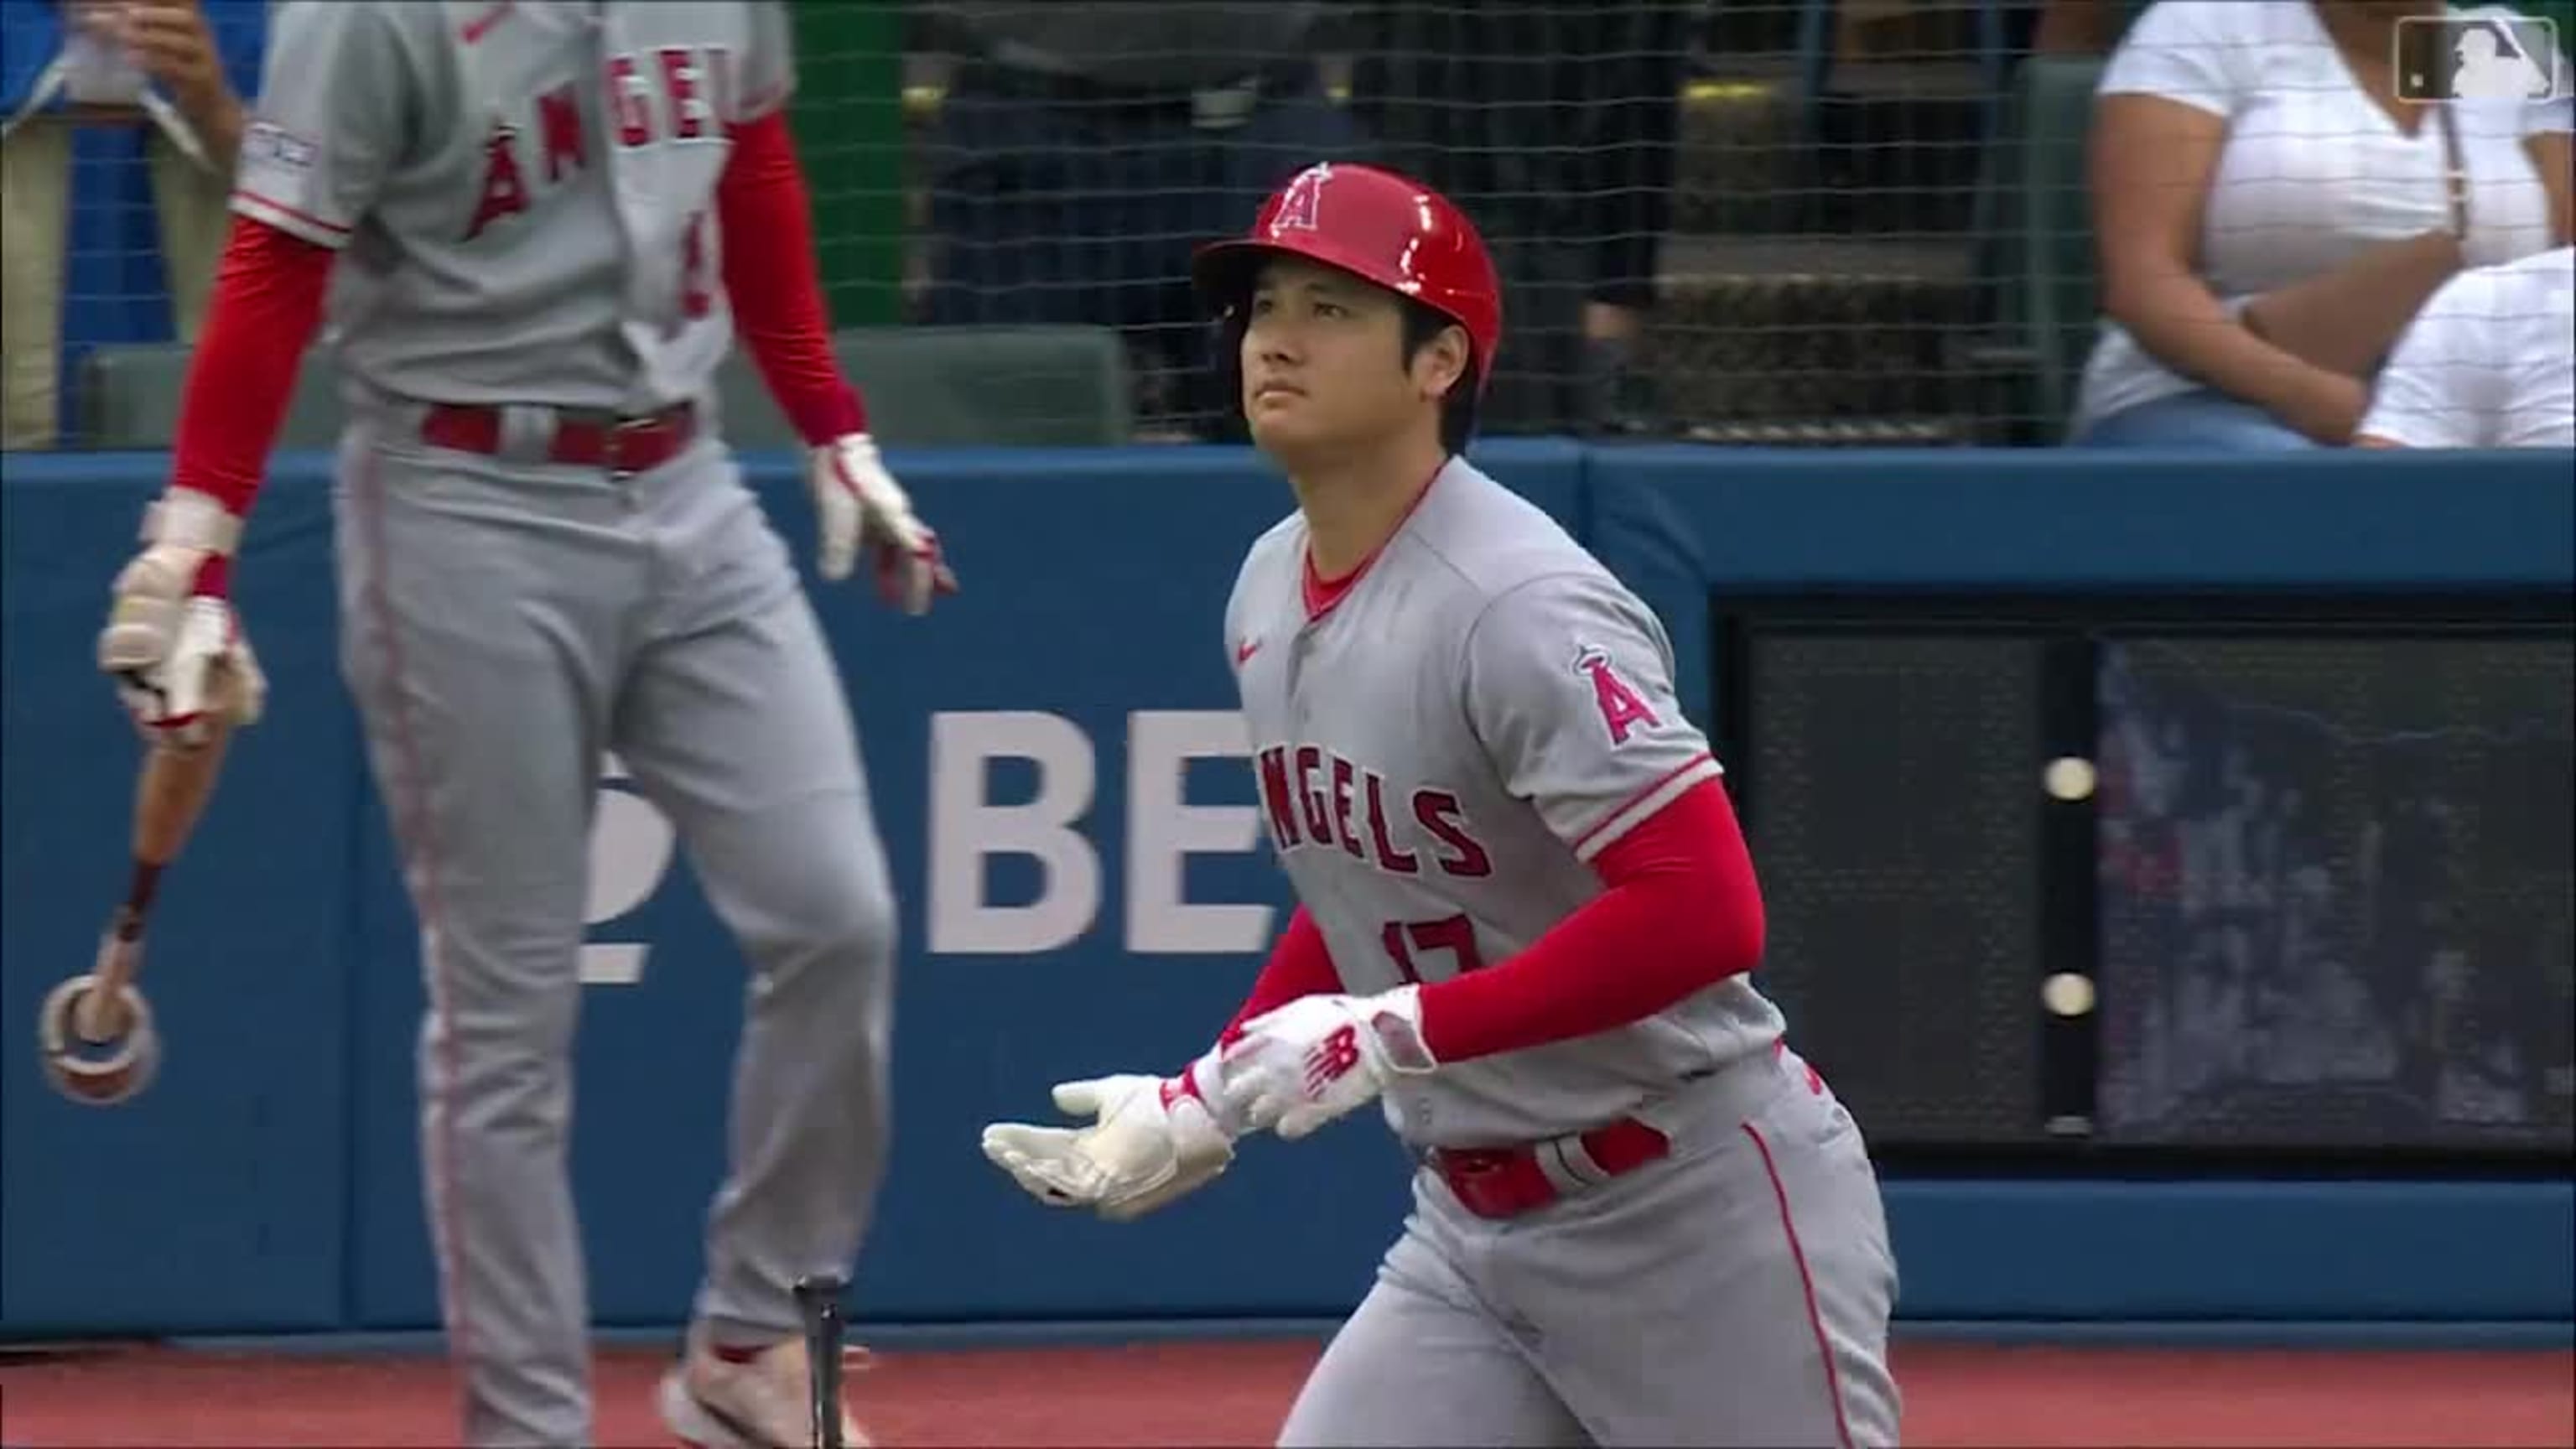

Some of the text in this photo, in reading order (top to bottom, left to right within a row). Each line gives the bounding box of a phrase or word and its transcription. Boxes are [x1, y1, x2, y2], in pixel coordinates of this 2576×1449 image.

[1271, 165, 1325, 231] A
[1585, 651, 1662, 747] A
[1380, 914, 1483, 984] 17
